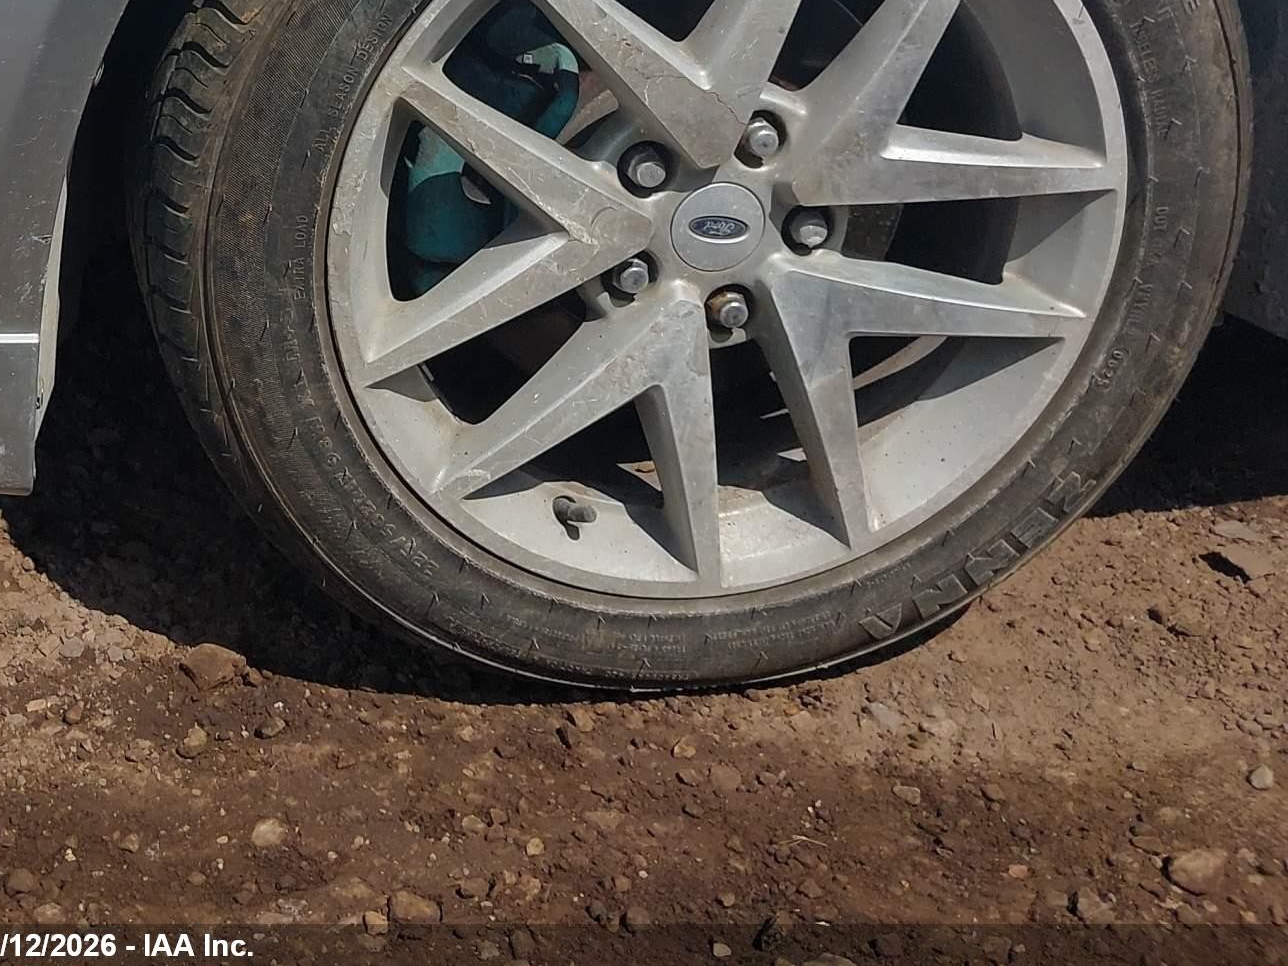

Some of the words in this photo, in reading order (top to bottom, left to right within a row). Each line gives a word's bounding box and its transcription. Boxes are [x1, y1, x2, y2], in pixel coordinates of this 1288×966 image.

[356, 15, 393, 61] DESIGN
[703, 221, 736, 236] Ford
[859, 470, 1097, 640] ZENNA
